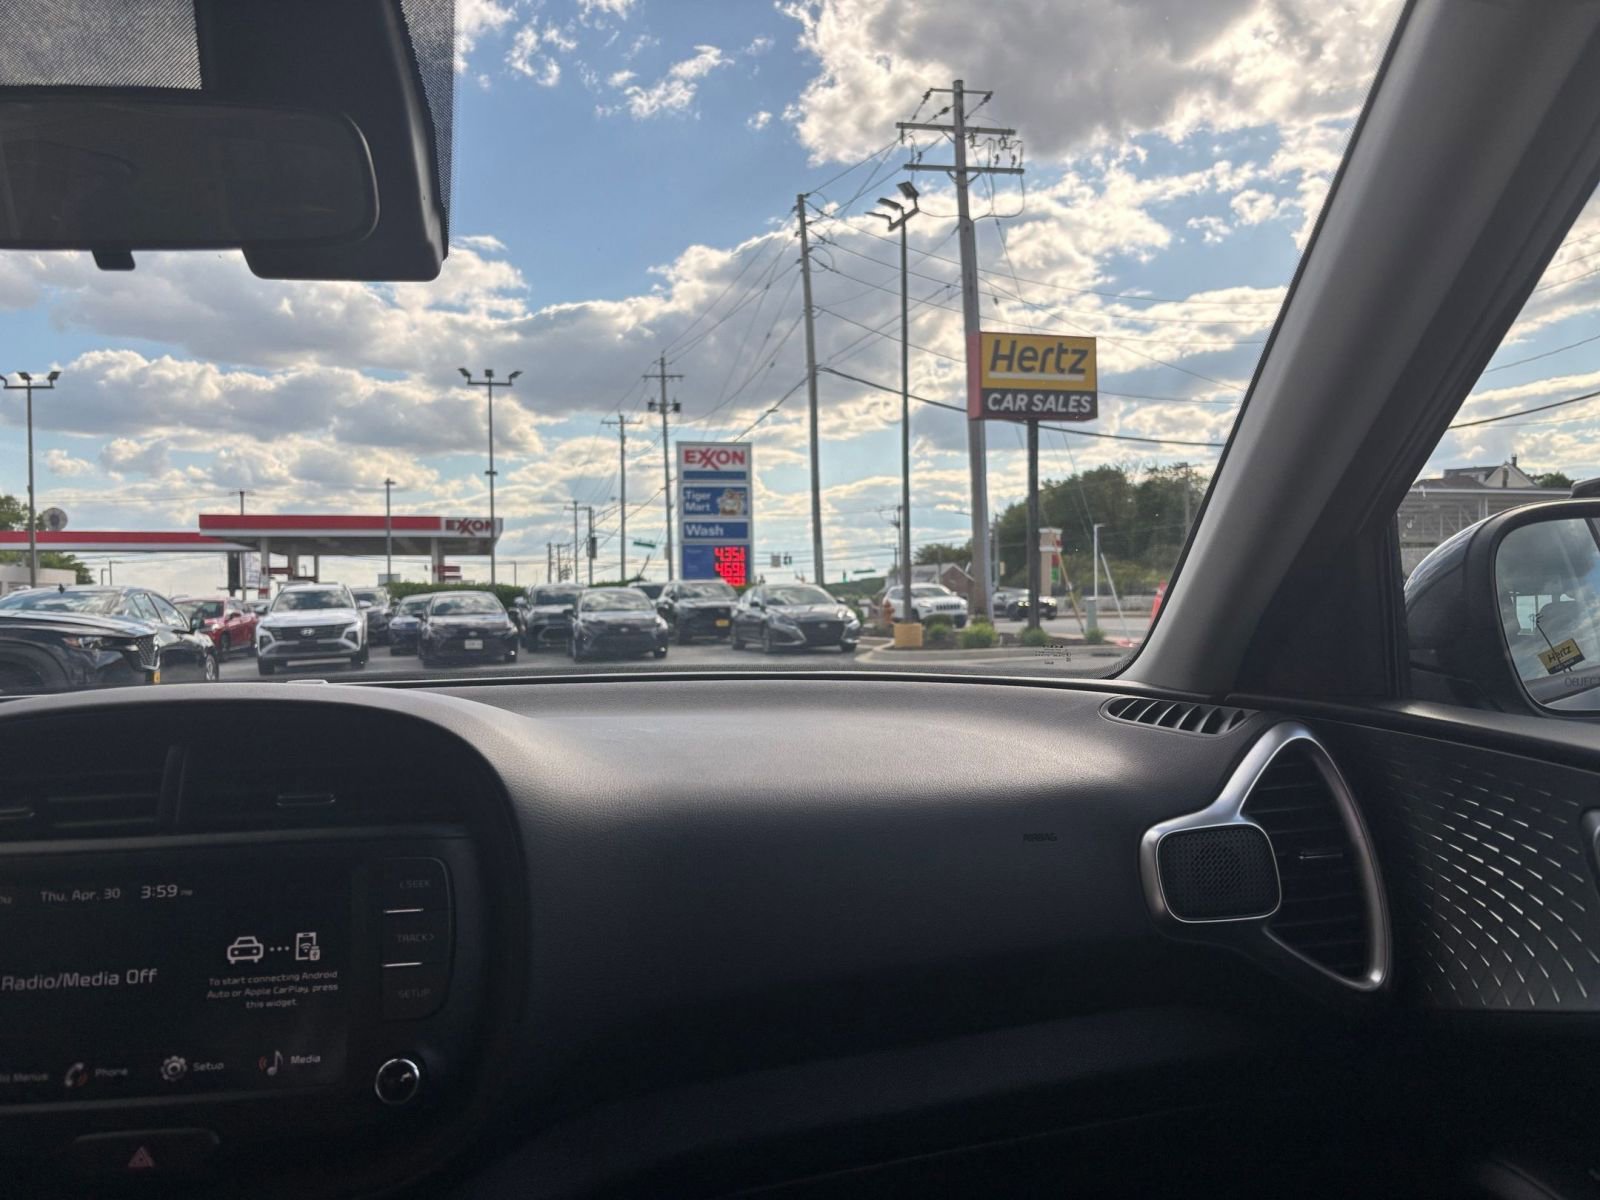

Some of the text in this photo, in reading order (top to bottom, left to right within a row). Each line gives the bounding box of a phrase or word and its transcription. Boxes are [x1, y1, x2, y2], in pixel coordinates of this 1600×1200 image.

[989, 338, 1089, 375] Hertz
[987, 393, 1091, 413] CAR SALES
[684, 448, 746, 471] EXXON
[685, 490, 711, 503] Tiger
[685, 501, 711, 512] Mart
[446, 518, 494, 536] EXXON
[685, 525, 724, 537] Wash
[1547, 646, 1573, 663] Hertz
[104, 888, 121, 900] 30
[140, 884, 179, 899] 3:59
[1, 968, 158, 992] Radio/Media Off
[209, 971, 338, 987] To start connecting Android
[207, 989, 230, 999] Auto
[244, 987, 271, 998] Apple
[312, 983, 339, 993] press
[245, 1000, 264, 1008] this
[193, 1060, 225, 1072] Setup
[290, 1054, 321, 1065] Media
[95, 1066, 128, 1077] Phone
